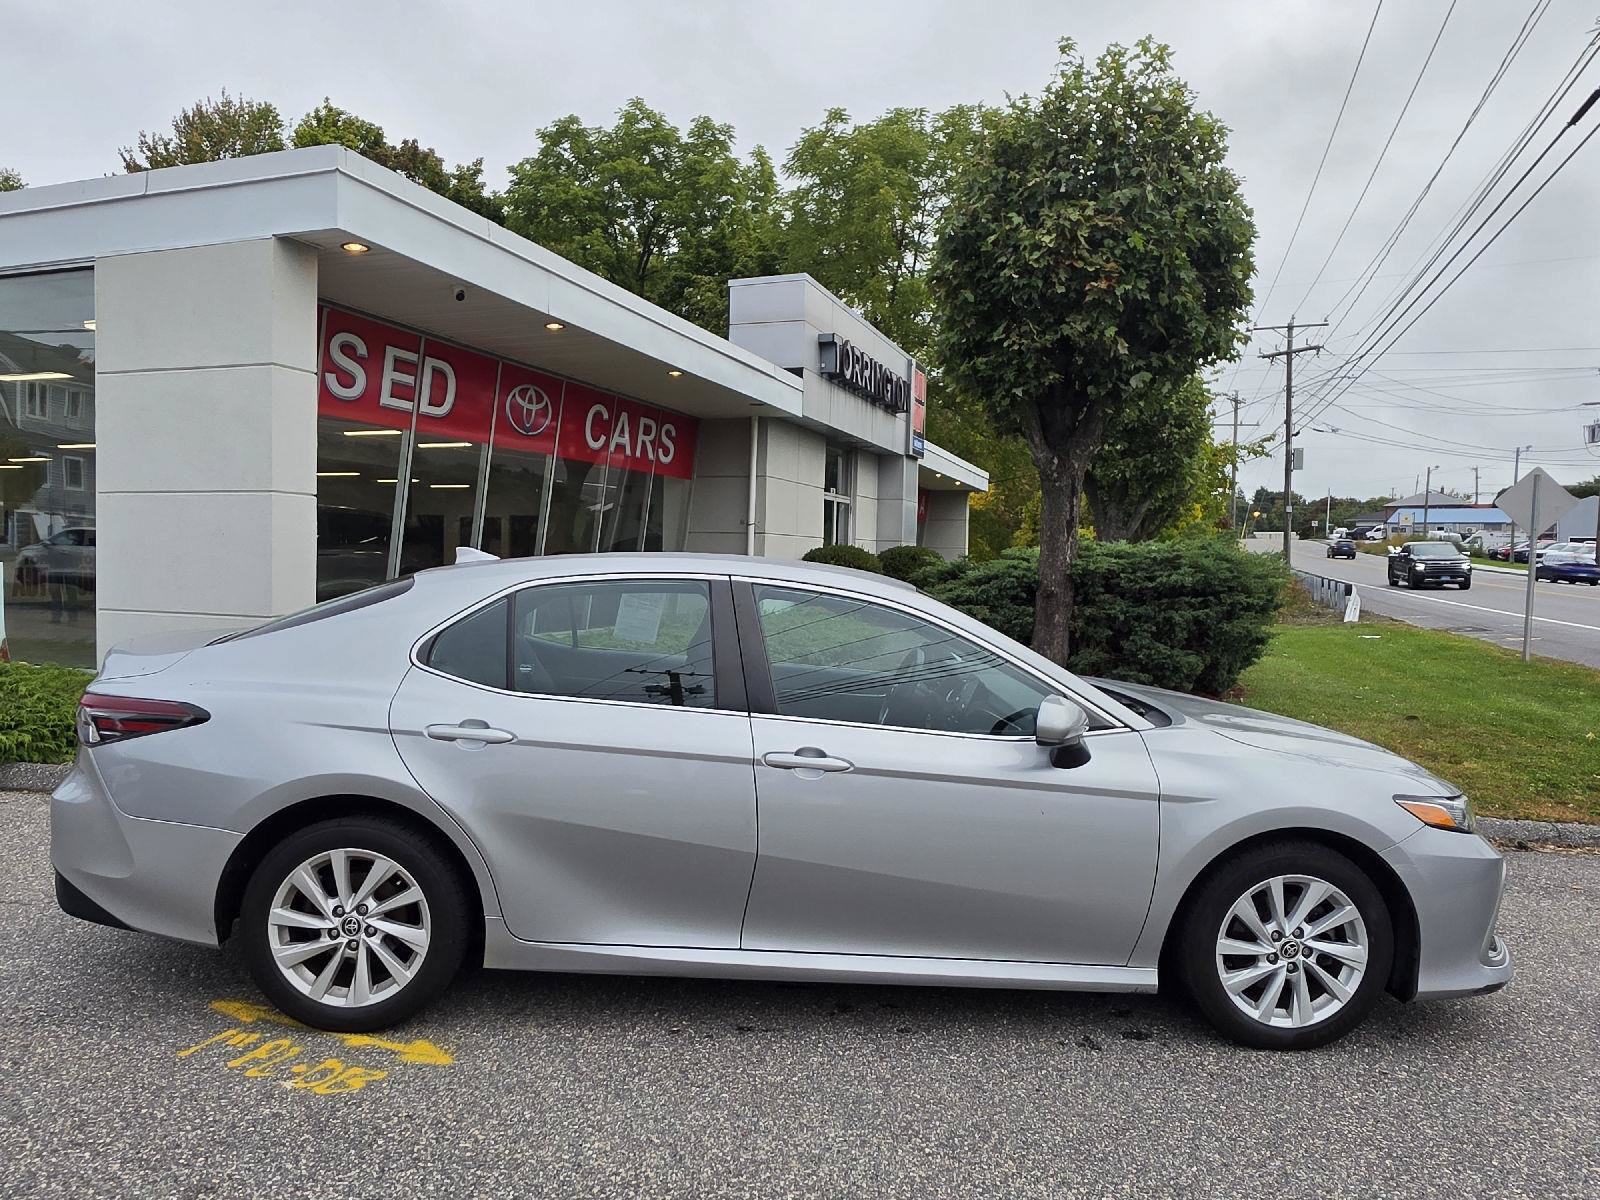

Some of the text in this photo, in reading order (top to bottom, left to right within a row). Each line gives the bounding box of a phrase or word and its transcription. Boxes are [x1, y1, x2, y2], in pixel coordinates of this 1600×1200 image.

[325, 332, 676, 464] SED CARS
[818, 333, 910, 413] TORRINGTON
